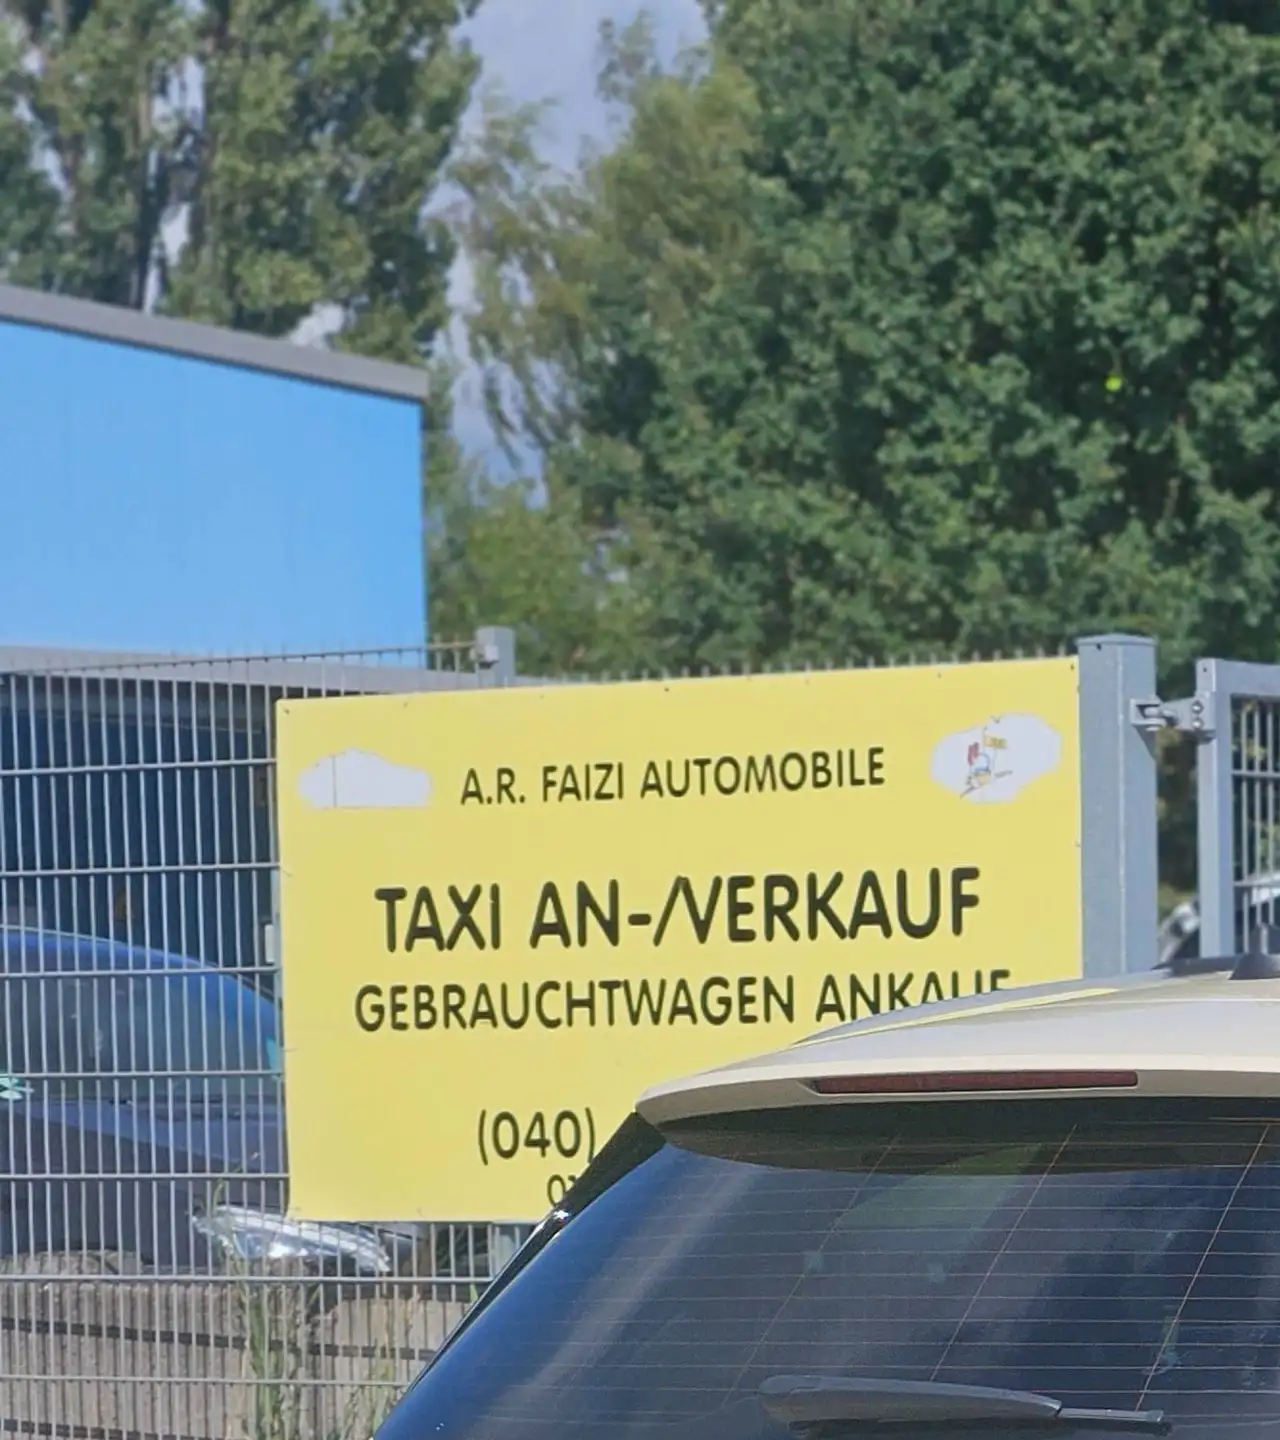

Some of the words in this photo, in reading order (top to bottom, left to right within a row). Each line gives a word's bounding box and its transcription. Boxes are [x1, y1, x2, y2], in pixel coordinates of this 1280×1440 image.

[460, 767, 526, 805] A.R.
[542, 762, 624, 802] FAIZI
[640, 747, 886, 799] AUTOMOBILE
[374, 884, 501, 953] TAXI
[529, 867, 980, 949] AN-/VERKAUF
[354, 974, 794, 1033] GEBRAUCHTWAGEN
[478, 1107, 595, 1166] (040)
